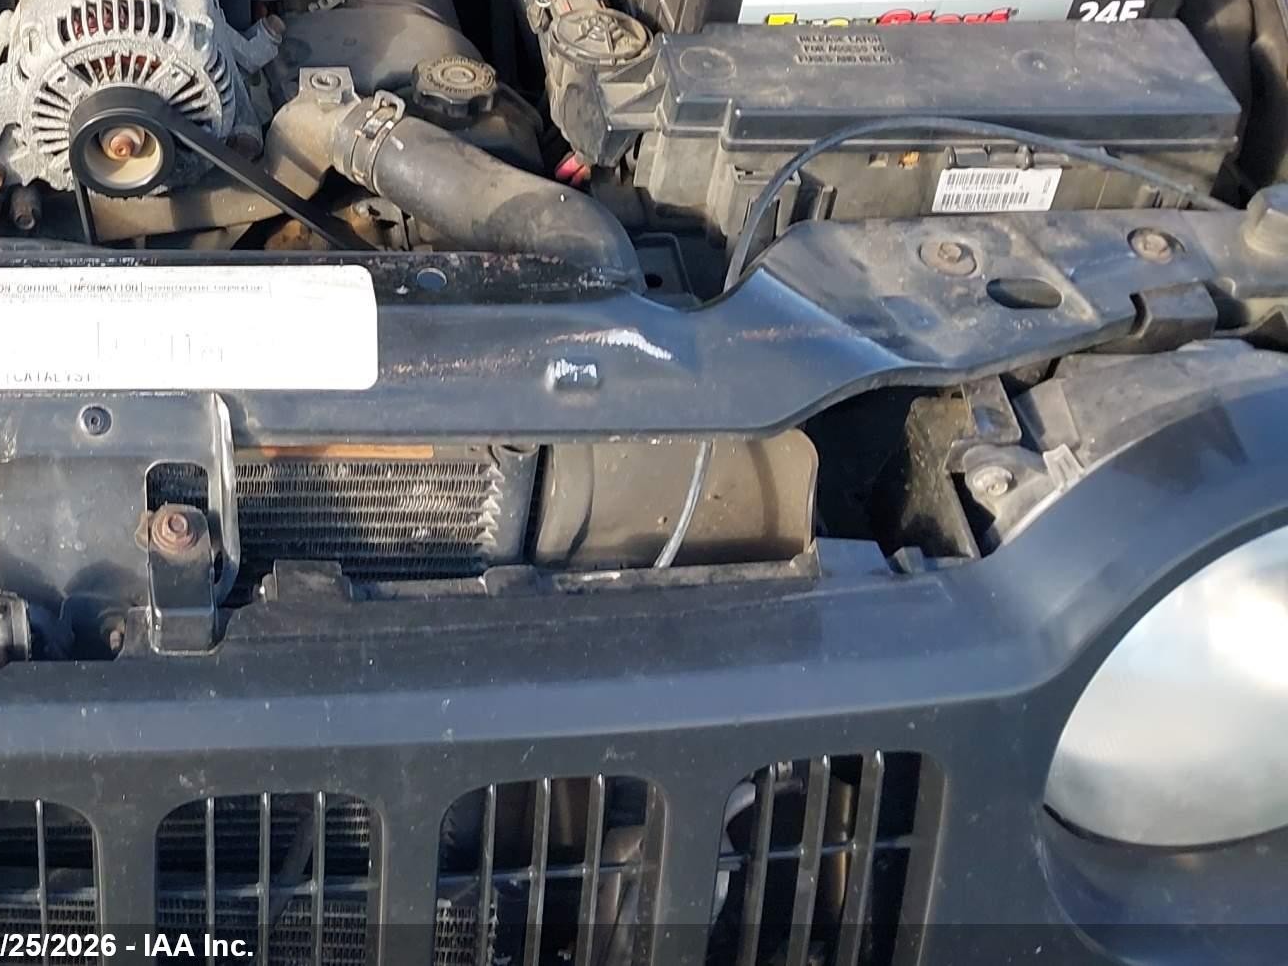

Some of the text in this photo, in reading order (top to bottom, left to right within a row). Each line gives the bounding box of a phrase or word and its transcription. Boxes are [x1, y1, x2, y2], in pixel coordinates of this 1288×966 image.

[796, 34, 840, 44] RELEASE
[801, 44, 887, 54] FOR ACCESS TO
[834, 54, 857, 65] AND
[16, 282, 60, 293] CONTROL
[69, 282, 139, 293] INFORMATION
